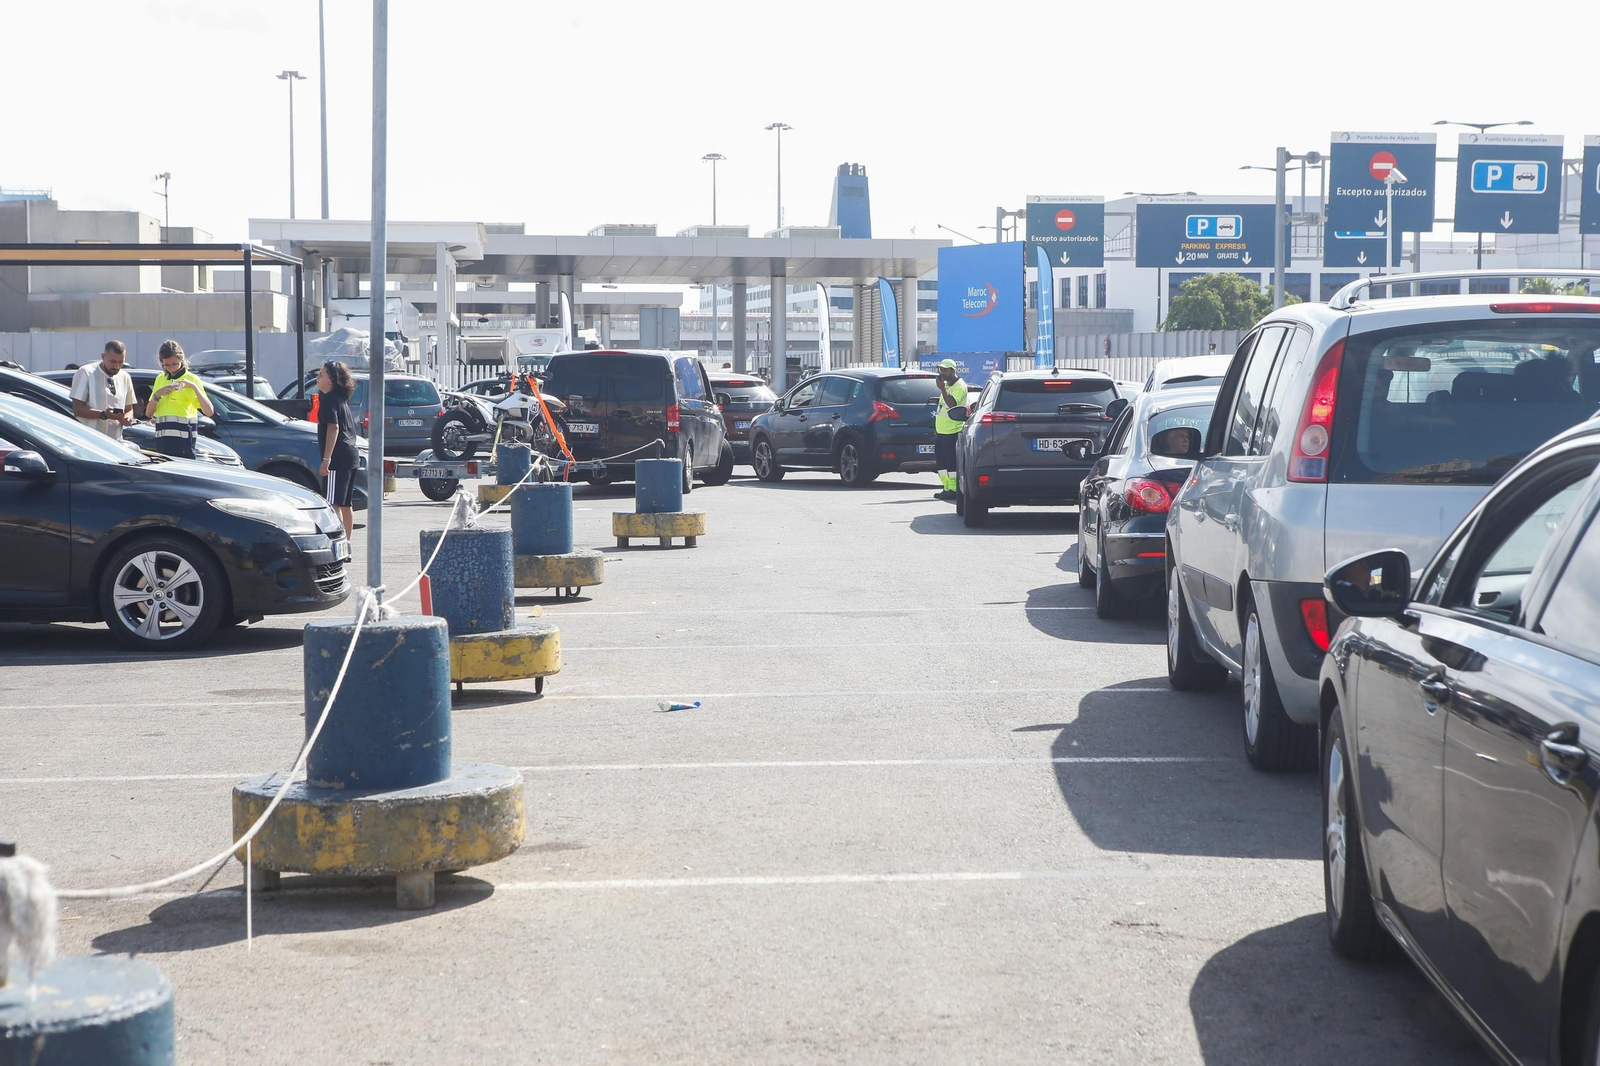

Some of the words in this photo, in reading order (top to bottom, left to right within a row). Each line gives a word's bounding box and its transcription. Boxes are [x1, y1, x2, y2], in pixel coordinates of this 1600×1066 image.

[1486, 165, 1503, 188] P
[1336, 187, 1372, 197] Excepto
[1374, 187, 1427, 197] autorizados
[1197, 218, 1209, 235] P
[1031, 235, 1058, 243] Excepto
[1186, 252, 1196, 260] 20
[967, 286, 987, 297] Maroc
[962, 298, 987, 309] Telecom
